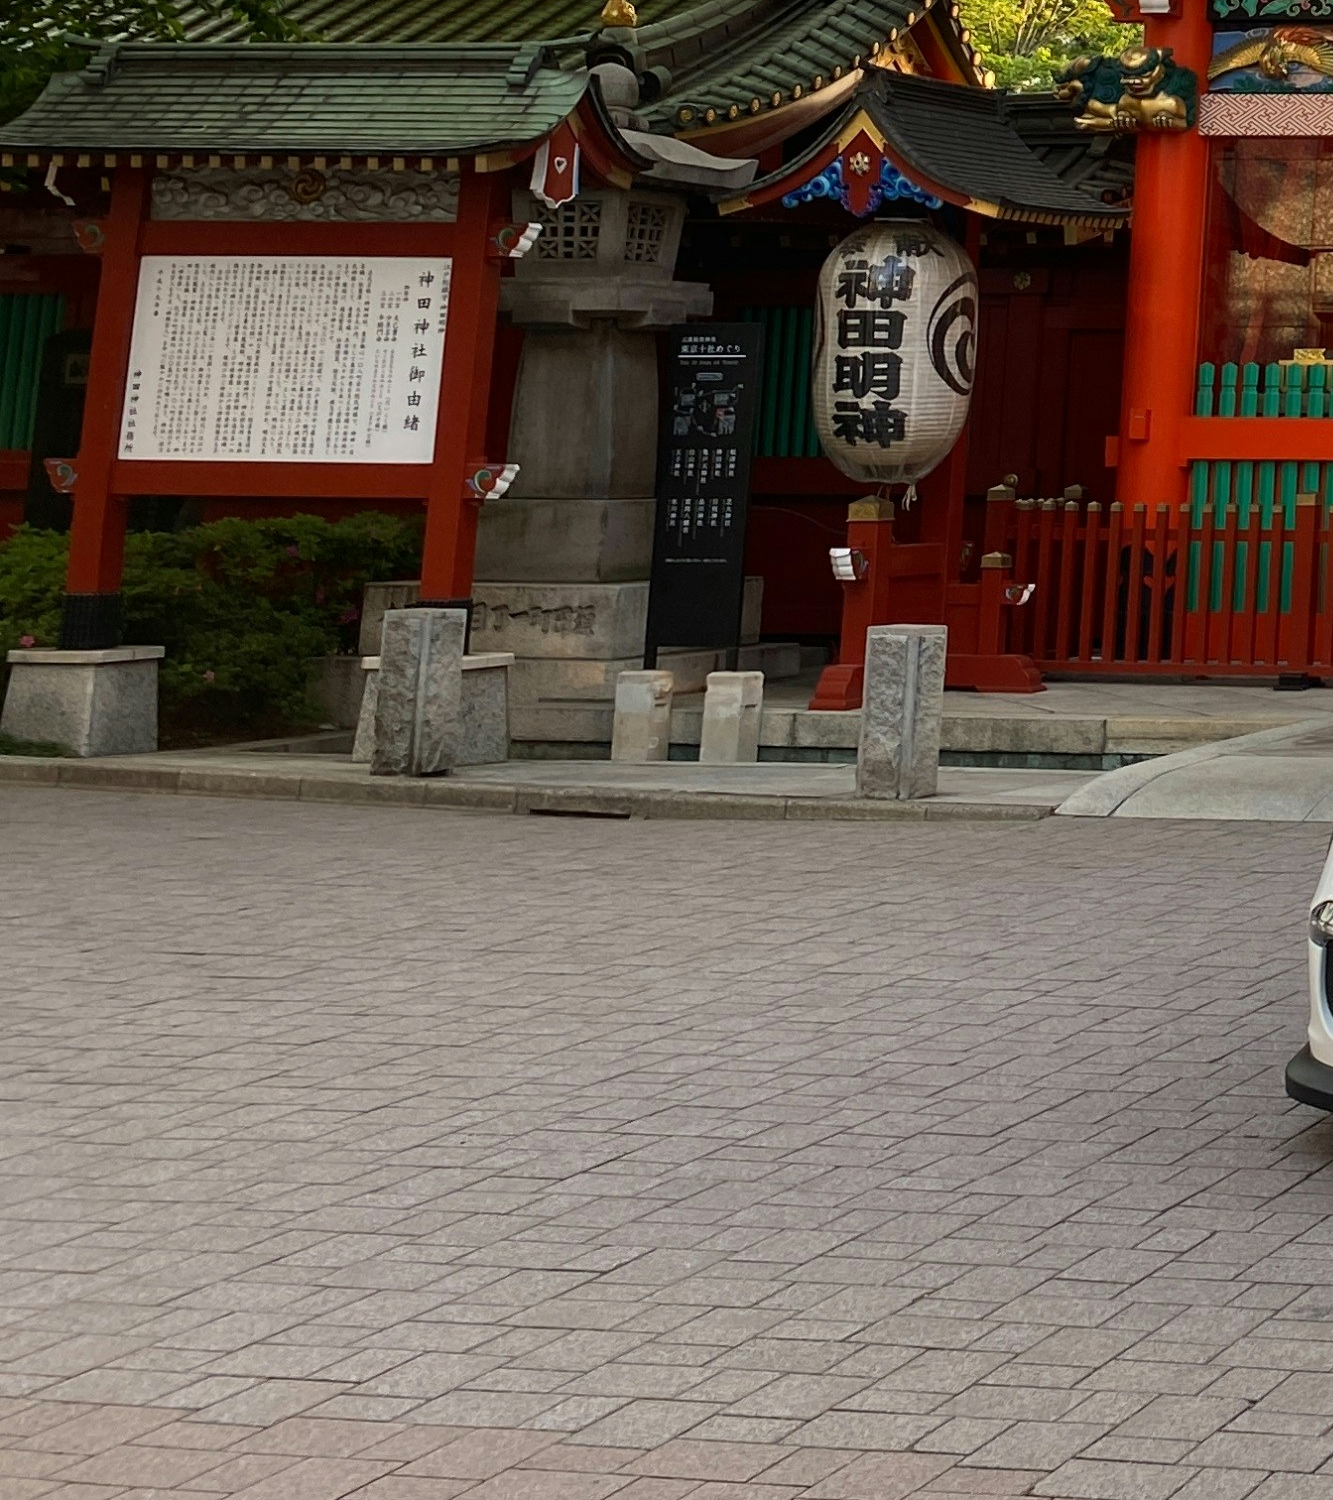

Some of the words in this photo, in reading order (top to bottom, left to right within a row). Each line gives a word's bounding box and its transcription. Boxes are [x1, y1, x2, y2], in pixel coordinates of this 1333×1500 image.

[402, 270, 435, 432] 神田神社御由緒
[832, 255, 916, 449] 神田明神
